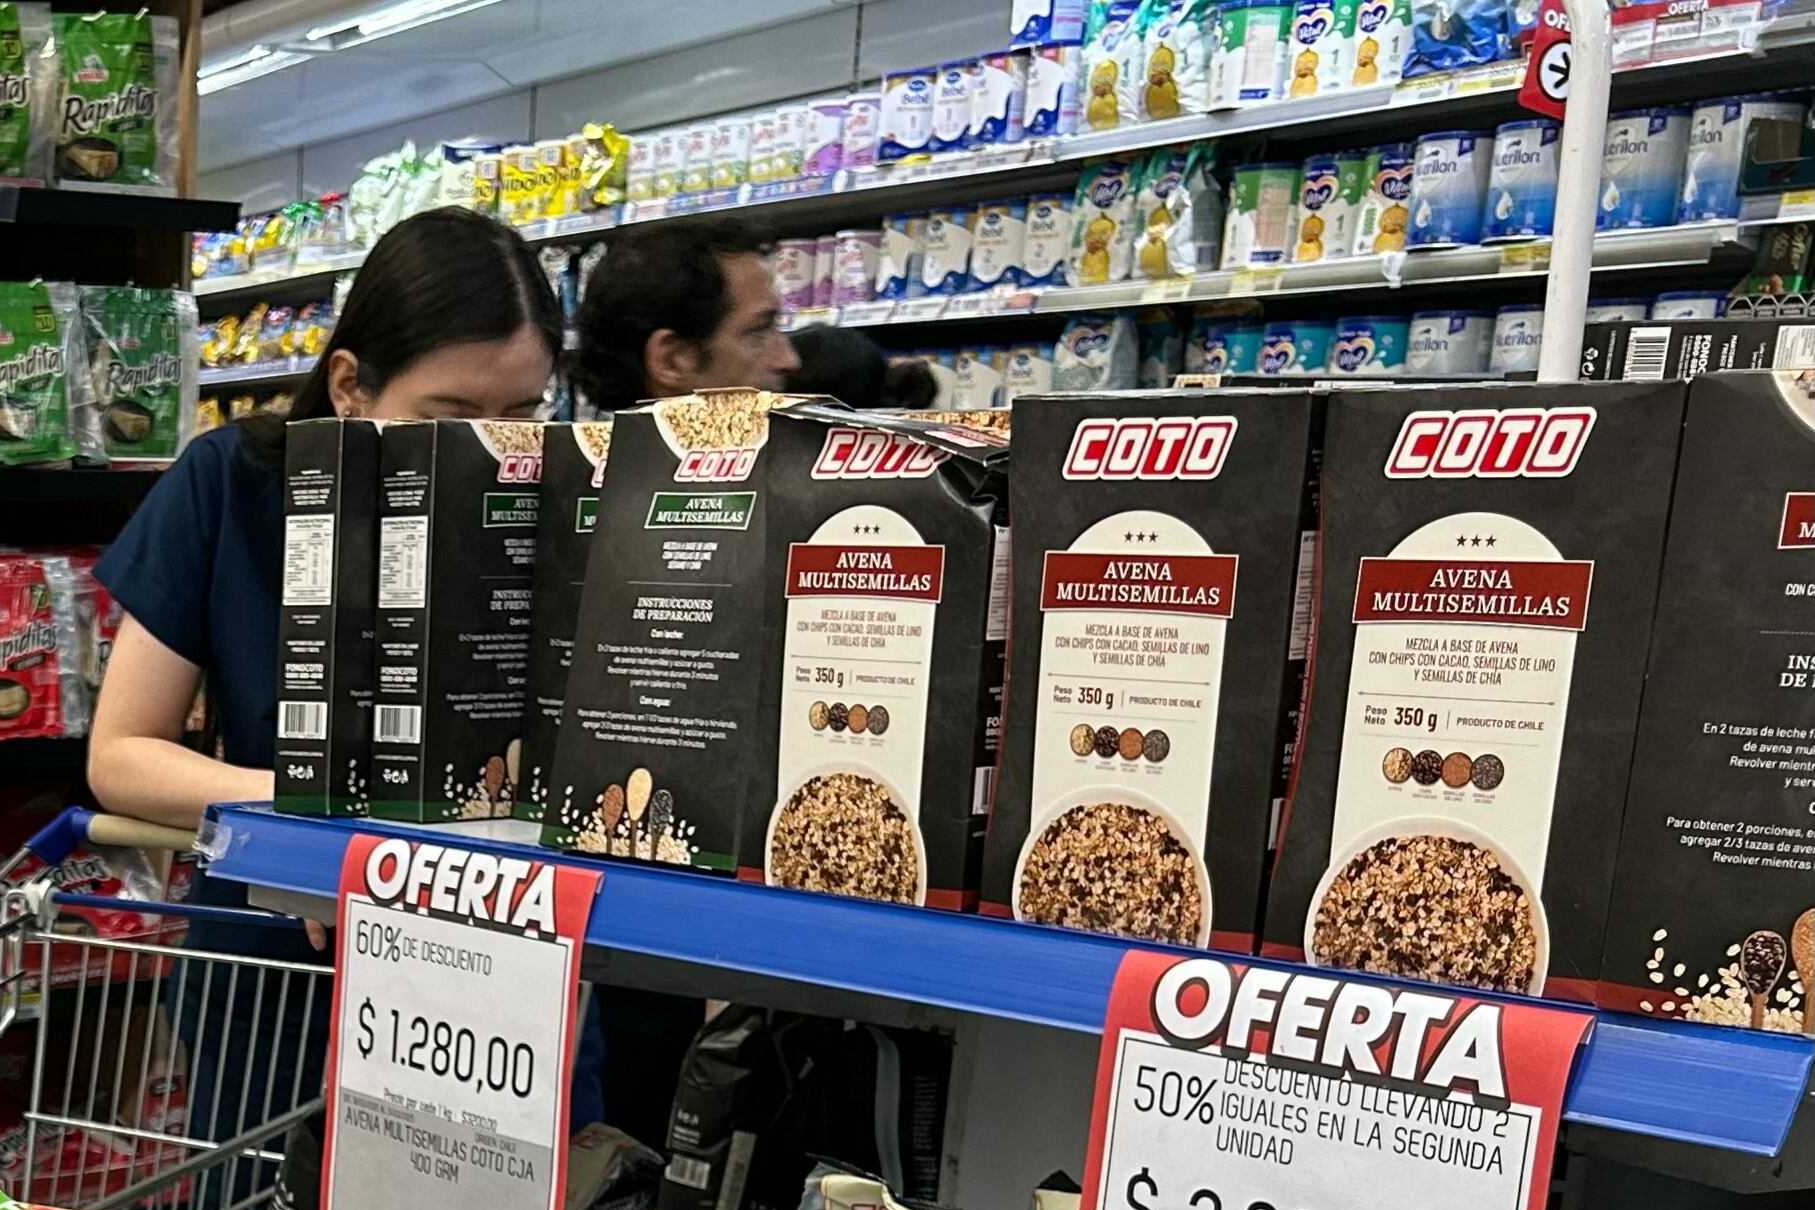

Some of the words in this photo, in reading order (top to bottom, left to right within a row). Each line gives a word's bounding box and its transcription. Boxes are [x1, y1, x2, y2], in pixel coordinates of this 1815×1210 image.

[64, 85, 158, 134] Rapiditas
[106, 352, 183, 398] Rapiditas
[1062, 416, 1238, 480] COTO
[1384, 407, 1597, 479] COTO
[674, 449, 760, 482] COTO
[685, 498, 724, 510] AVENA
[656, 510, 745, 524] MULTISEMILLAS
[835, 551, 893, 570] AVENA
[1103, 561, 1173, 581] AVENA
[798, 571, 932, 592] MULTISEMILLAS
[1429, 568, 1513, 590] AVENA
[1786, 583, 1806, 597] CON
[1056, 583, 1221, 606] MULTISEMILLAS
[1372, 592, 1571, 617] MULTISEMILLAS
[1406, 638, 1439, 651] MEZCLA
[1450, 640, 1473, 653] BASE
[1488, 642, 1519, 655] AVENA
[1389, 653, 1416, 667] CHIPS
[1473, 657, 1517, 671] SEMILLAS
[815, 667, 835, 684] 350
[1421, 670, 1463, 684] SEMILLAS
[1780, 672, 1807, 688] DE
[1077, 687, 1102, 705] 350
[1394, 707, 1423, 726] 350
[1427, 713, 1438, 732] g
[1456, 717, 1503, 728] PRODUCTO
[1518, 721, 1544, 731] CHILE
[1703, 722, 1718, 734] En
[1728, 724, 1758, 736] tazas
[1760, 726, 1774, 737] de
[1776, 726, 1807, 739] leche
[1743, 741, 1757, 752] de
[1759, 744, 1792, 755] avena
[1729, 756, 1776, 769] Revolver
[1666, 816, 1691, 829] Para
[1692, 819, 1735, 833] obtener
[1745, 824, 1804, 838] porciones,
[1680, 834, 1722, 849] agregar
[1723, 837, 1743, 849] 2/3
[1745, 840, 1774, 851] tazas
[1712, 851, 1759, 866] Revolver
[1761, 855, 1812, 870] mientras
[365, 838, 558, 934] OFERTA
[356, 919, 402, 962] 60%
[403, 938, 417, 959] DE
[421, 941, 492, 976] DESCUENTO
[1153, 958, 1509, 1104] OFERTA
[357, 997, 376, 1060] $
[390, 1009, 534, 1098] 1.280,00
[1133, 1064, 1218, 1126] 50%
[1224, 1058, 1352, 1108] DESCUENTO
[1360, 1083, 1485, 1133] LLEVANDO
[1491, 1109, 1510, 1139] 2
[344, 1106, 380, 1135] AVENA
[383, 1117, 468, 1162] MULTISEMILLAS
[470, 1144, 505, 1172] COTO
[507, 1155, 535, 1182] CJA
[1219, 1091, 1309, 1134] IGUALES
[1317, 1110, 1345, 1143] EN
[1353, 1118, 1382, 1150] LA
[1393, 1128, 1504, 1176] SEGUNDA
[1215, 1125, 1294, 1167] UNIDAD
[409, 1150, 432, 1175] 400
